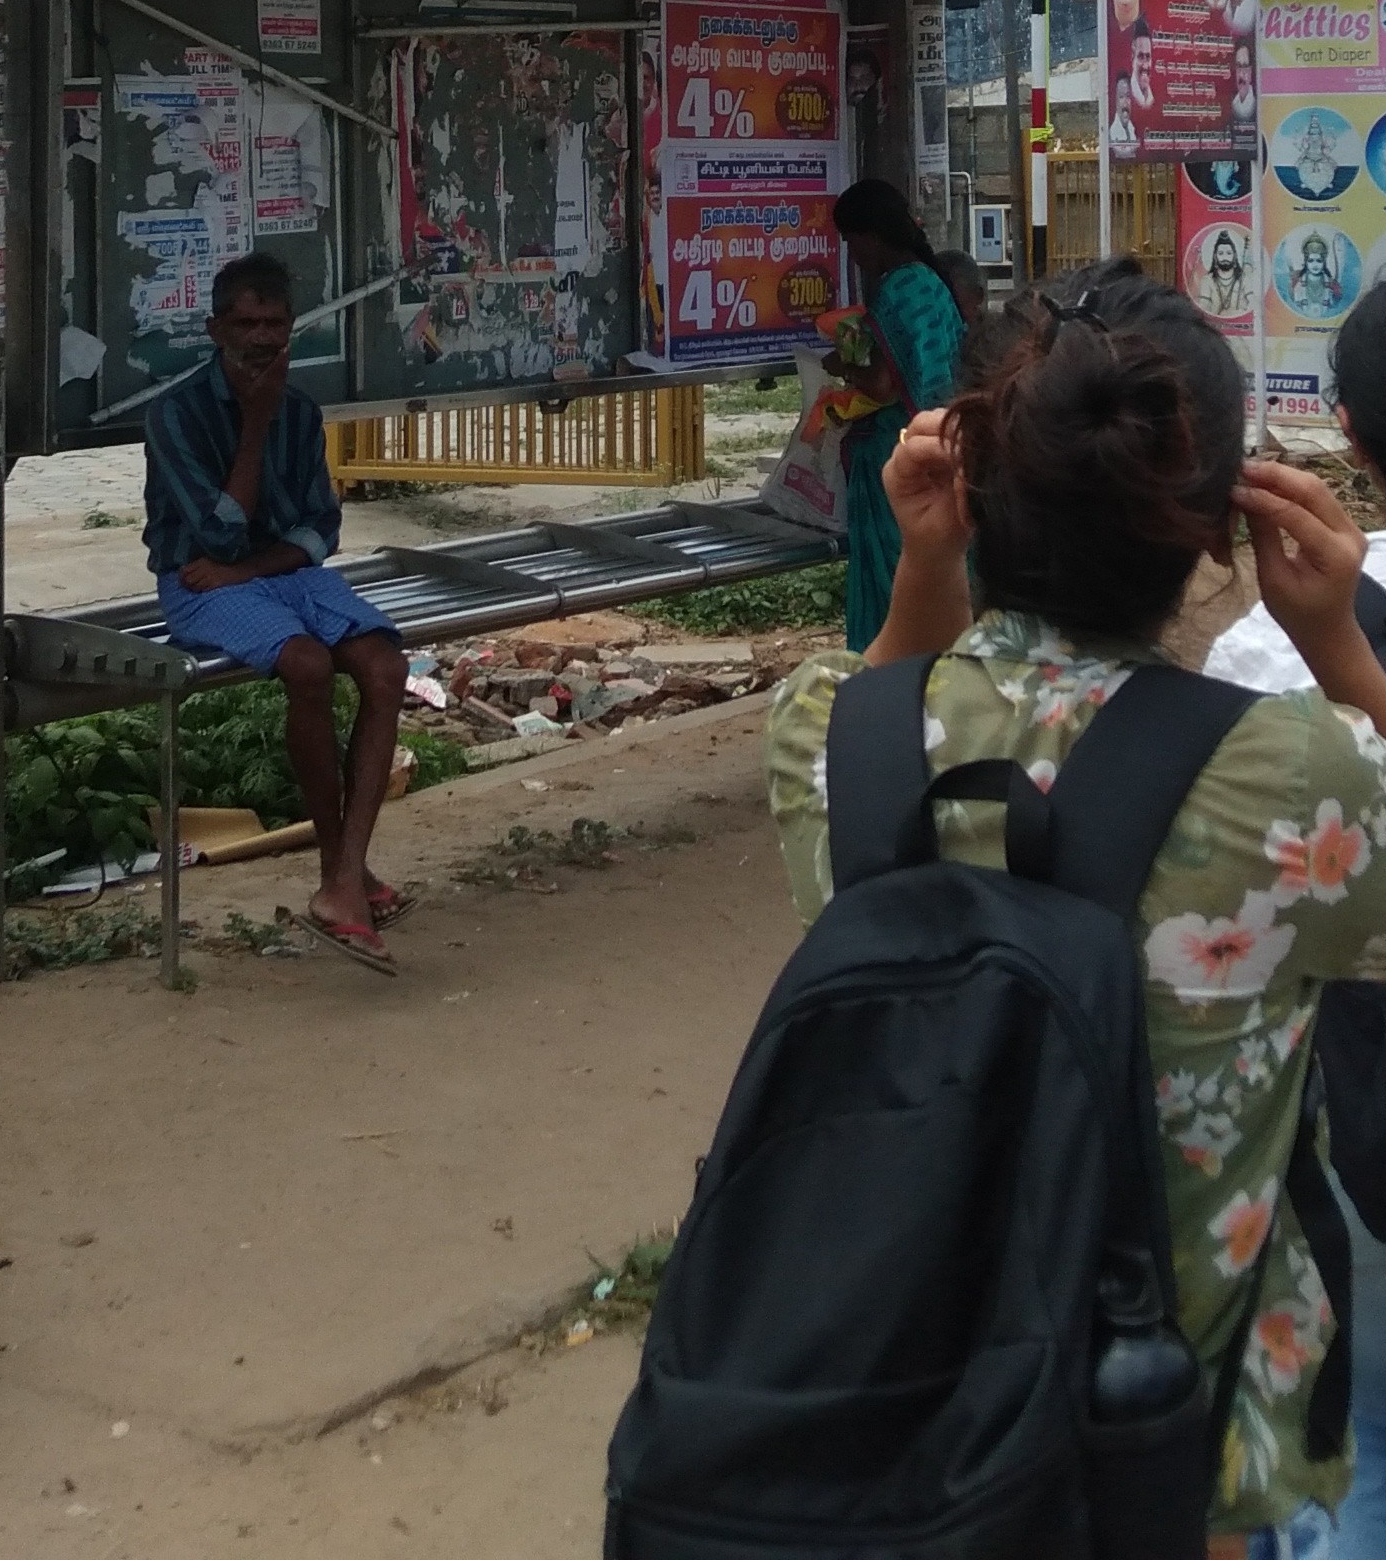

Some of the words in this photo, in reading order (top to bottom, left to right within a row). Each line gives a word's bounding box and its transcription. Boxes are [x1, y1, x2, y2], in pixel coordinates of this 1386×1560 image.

[1261, 2, 1371, 41] hutties
[671, 41, 721, 74] அதிரடி
[726, 46, 763, 72] வட்டி
[1294, 46, 1326, 63] Pant
[1327, 46, 1372, 66] Diaper
[676, 77, 755, 138] 4%
[672, 233, 723, 267] அதிரடி
[728, 236, 764, 261] வட்டி
[678, 270, 758, 330] 4%
[1266, 378, 1312, 390] ITURE
